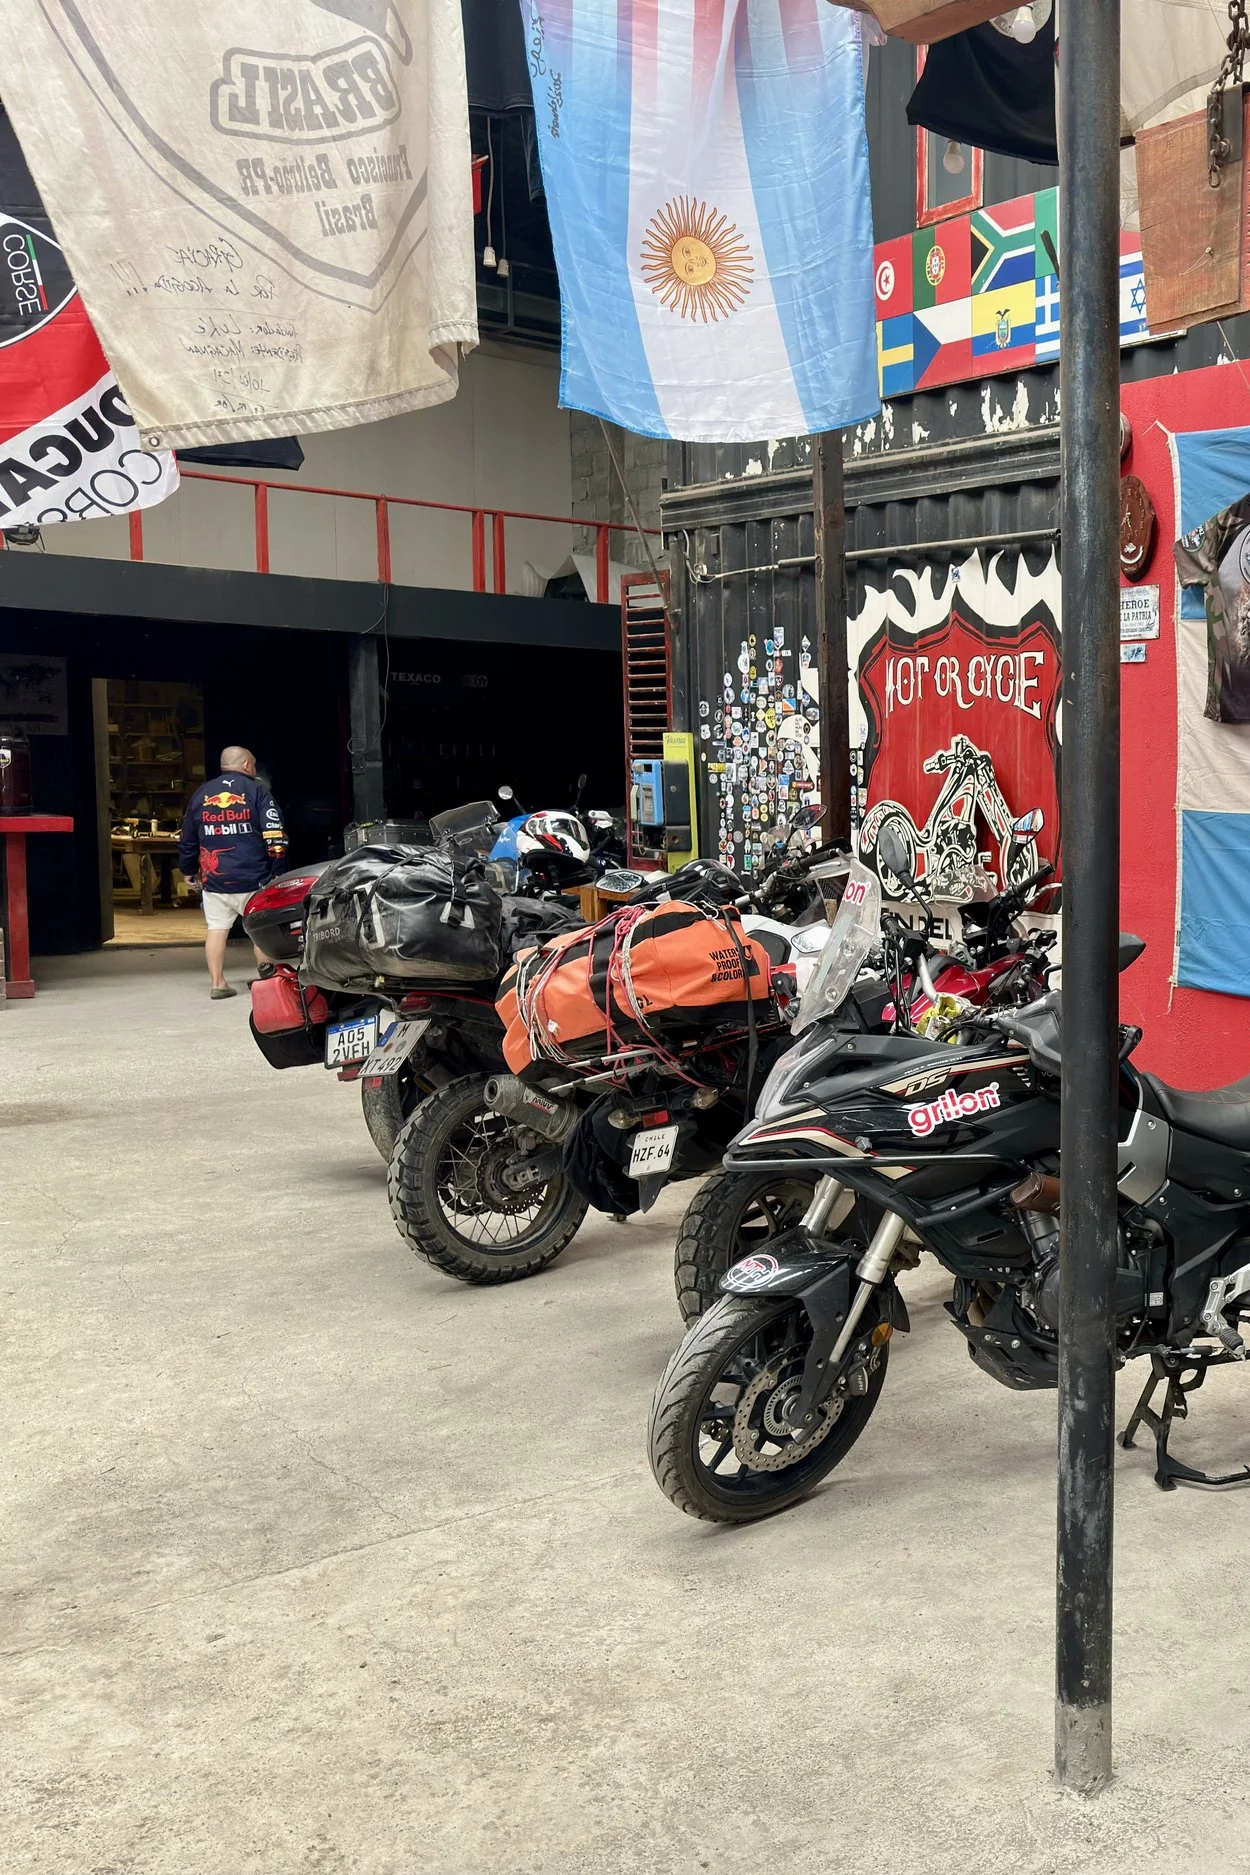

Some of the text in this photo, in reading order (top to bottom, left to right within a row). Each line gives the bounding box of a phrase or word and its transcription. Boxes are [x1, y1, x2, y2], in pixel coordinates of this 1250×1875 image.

[390, 671, 441, 683] TEXACO
[202, 808, 251, 822] Red Bull
[204, 823, 237, 836] Mobil
[313, 927, 341, 941] TRIBORD
[337, 1027, 365, 1047] A05
[904, 1068, 952, 1097] DS
[909, 1086, 999, 1135] grilon
